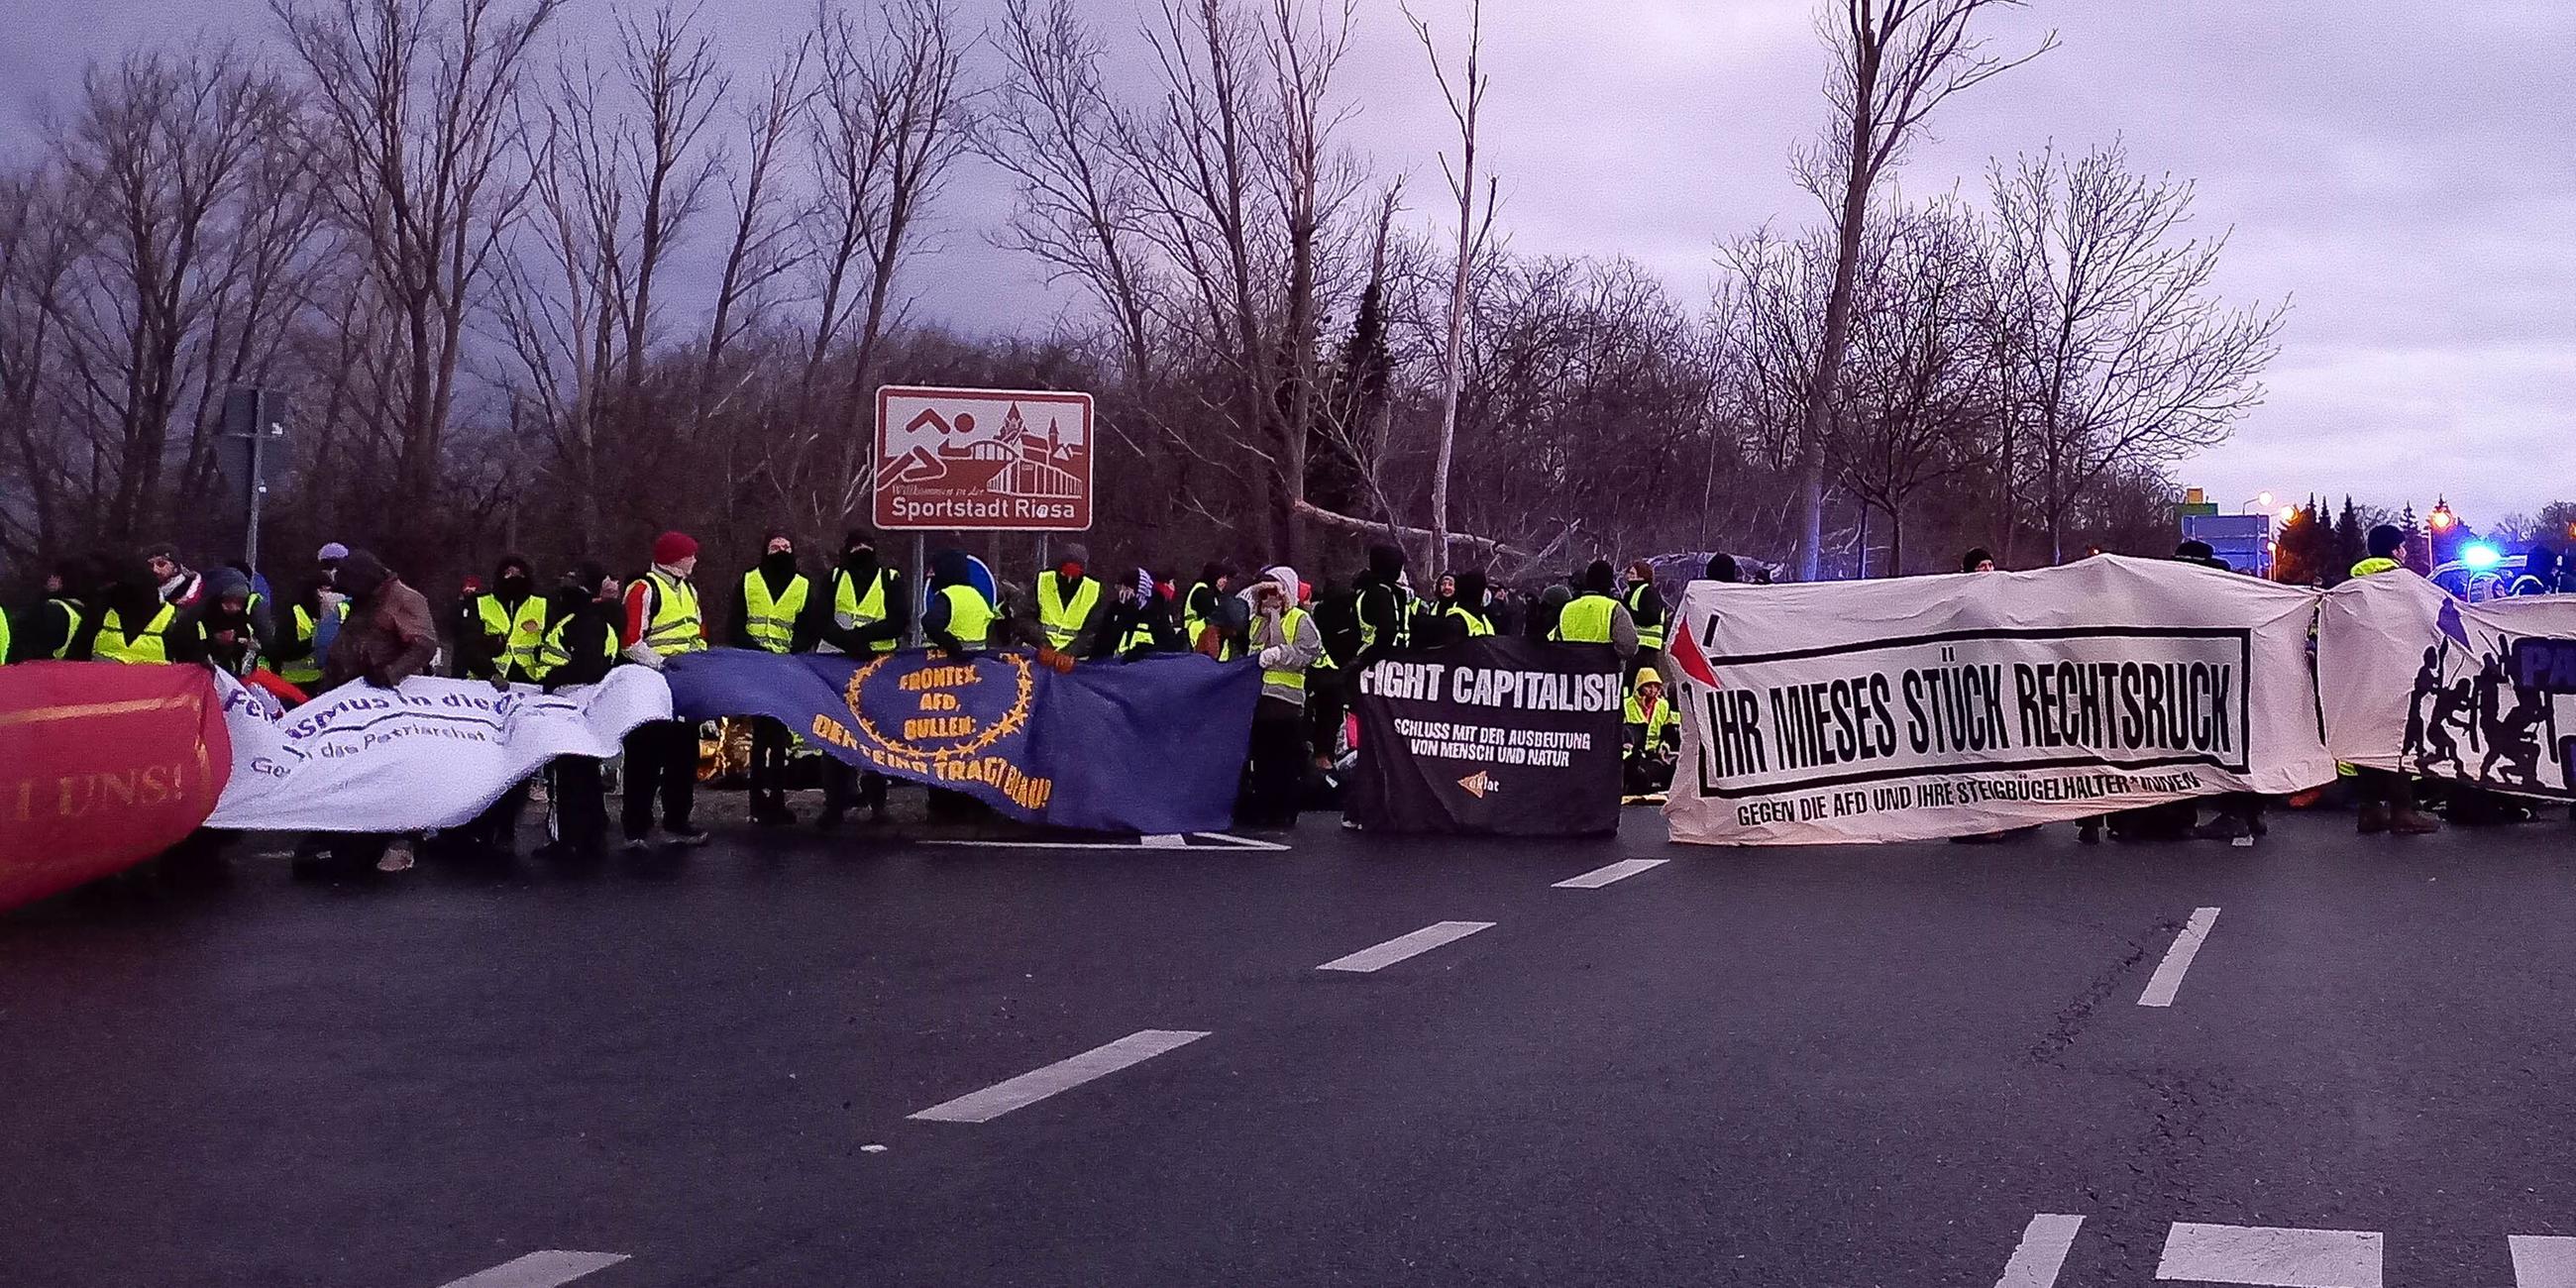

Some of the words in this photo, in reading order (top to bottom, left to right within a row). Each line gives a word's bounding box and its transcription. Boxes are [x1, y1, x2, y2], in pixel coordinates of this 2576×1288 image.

[892, 496, 1009, 521] Sportstadt
[899, 664, 983, 691] FRONTEX,
[919, 693, 961, 712] AFD,
[1706, 689, 1768, 779] IHR
[1769, 672, 1897, 771] MIESES
[1901, 646, 2010, 755] STÜCK
[2012, 660, 2232, 753] RECHTSRUCK
[1394, 718, 1450, 740] SCHLUSS
[1452, 724, 1477, 742] MIT
[1479, 727, 1505, 746] DER
[1508, 729, 1591, 751] AUSBEUTUNG
[1411, 738, 1439, 757] VON
[1440, 741, 1494, 762] MENSCH
[1497, 746, 1526, 765] UND
[1527, 749, 1571, 768] NATUR
[56, 761, 183, 818] UNS!
[1737, 800, 1795, 826] GEGEN
[1800, 795, 1827, 821] DIE
[1833, 792, 1868, 817] AFD
[1874, 786, 1912, 812] UND
[1917, 782, 1954, 808] IHRE
